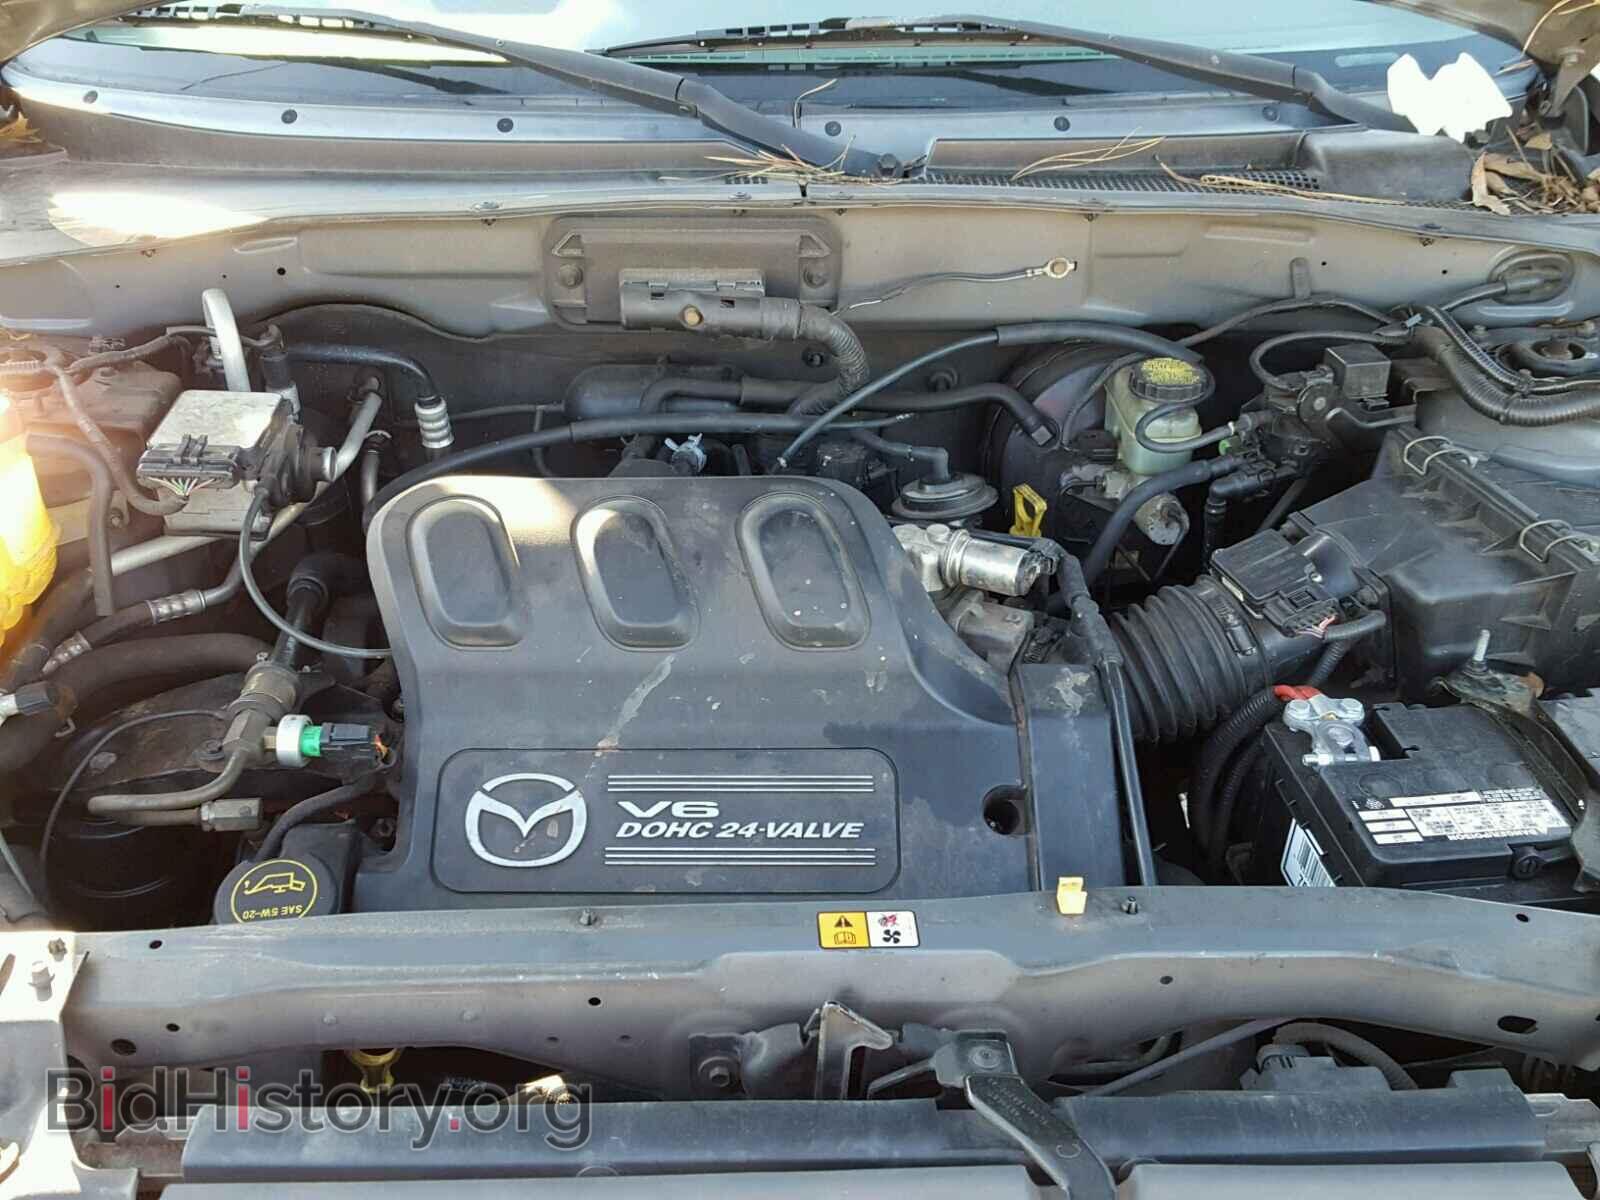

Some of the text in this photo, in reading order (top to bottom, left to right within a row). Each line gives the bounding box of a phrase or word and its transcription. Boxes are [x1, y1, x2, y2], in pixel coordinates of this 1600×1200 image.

[617, 800, 720, 818] V6
[615, 821, 865, 838] DOHC 24-VALVE
[242, 904, 303, 919] SAE 5W-20
